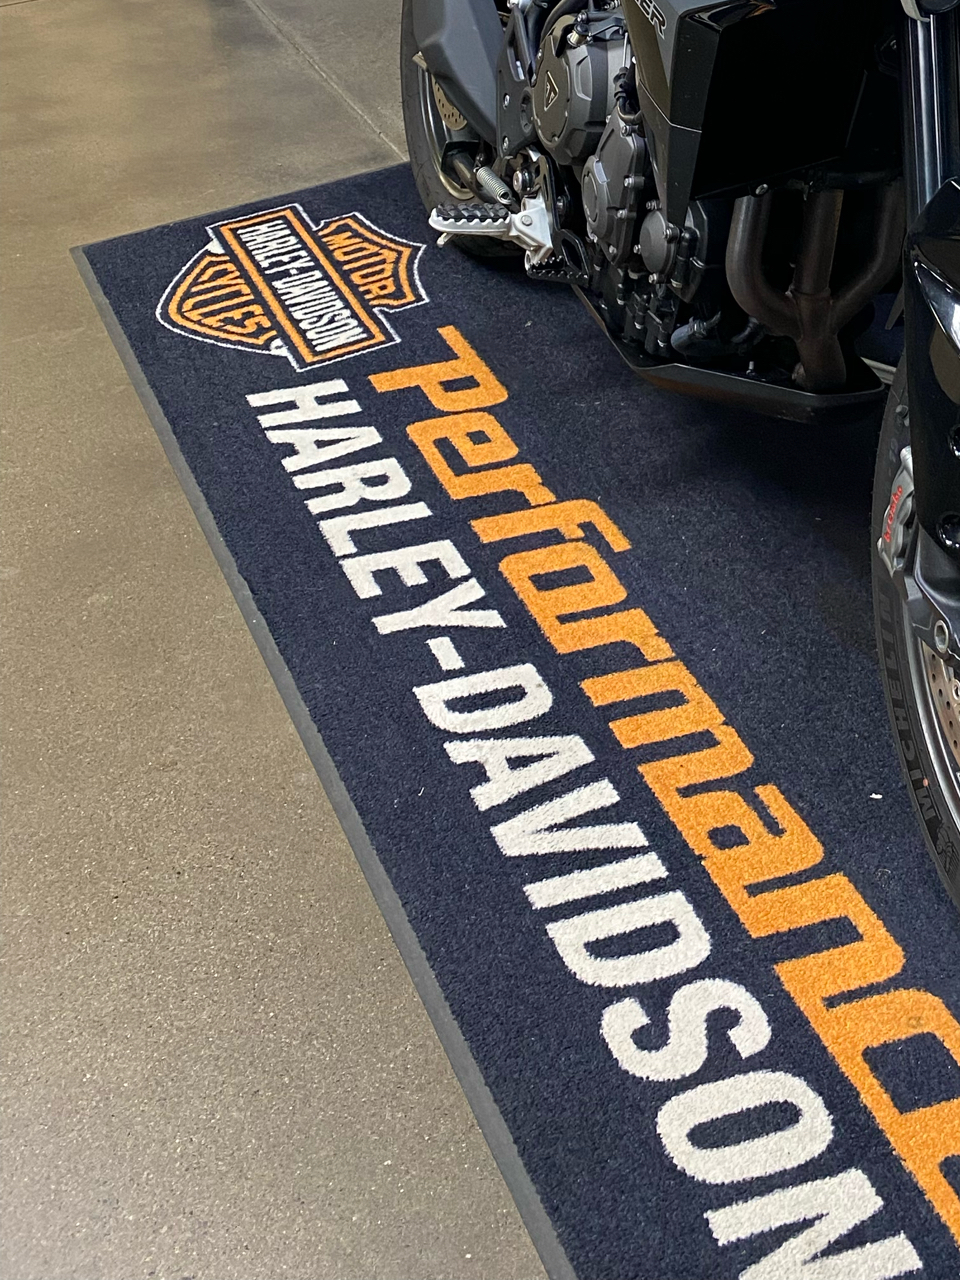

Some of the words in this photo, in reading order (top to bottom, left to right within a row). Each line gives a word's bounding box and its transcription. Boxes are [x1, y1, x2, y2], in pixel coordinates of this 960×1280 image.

[181, 262, 272, 335] CYCLES
[236, 219, 368, 352] HARLEY-DAVIDSON
[321, 231, 399, 300] MOTOR
[883, 484, 903, 543] brembo
[878, 592, 936, 820] MICHELIN
[244, 377, 924, 1280] HARLEY-DAVIDSON
